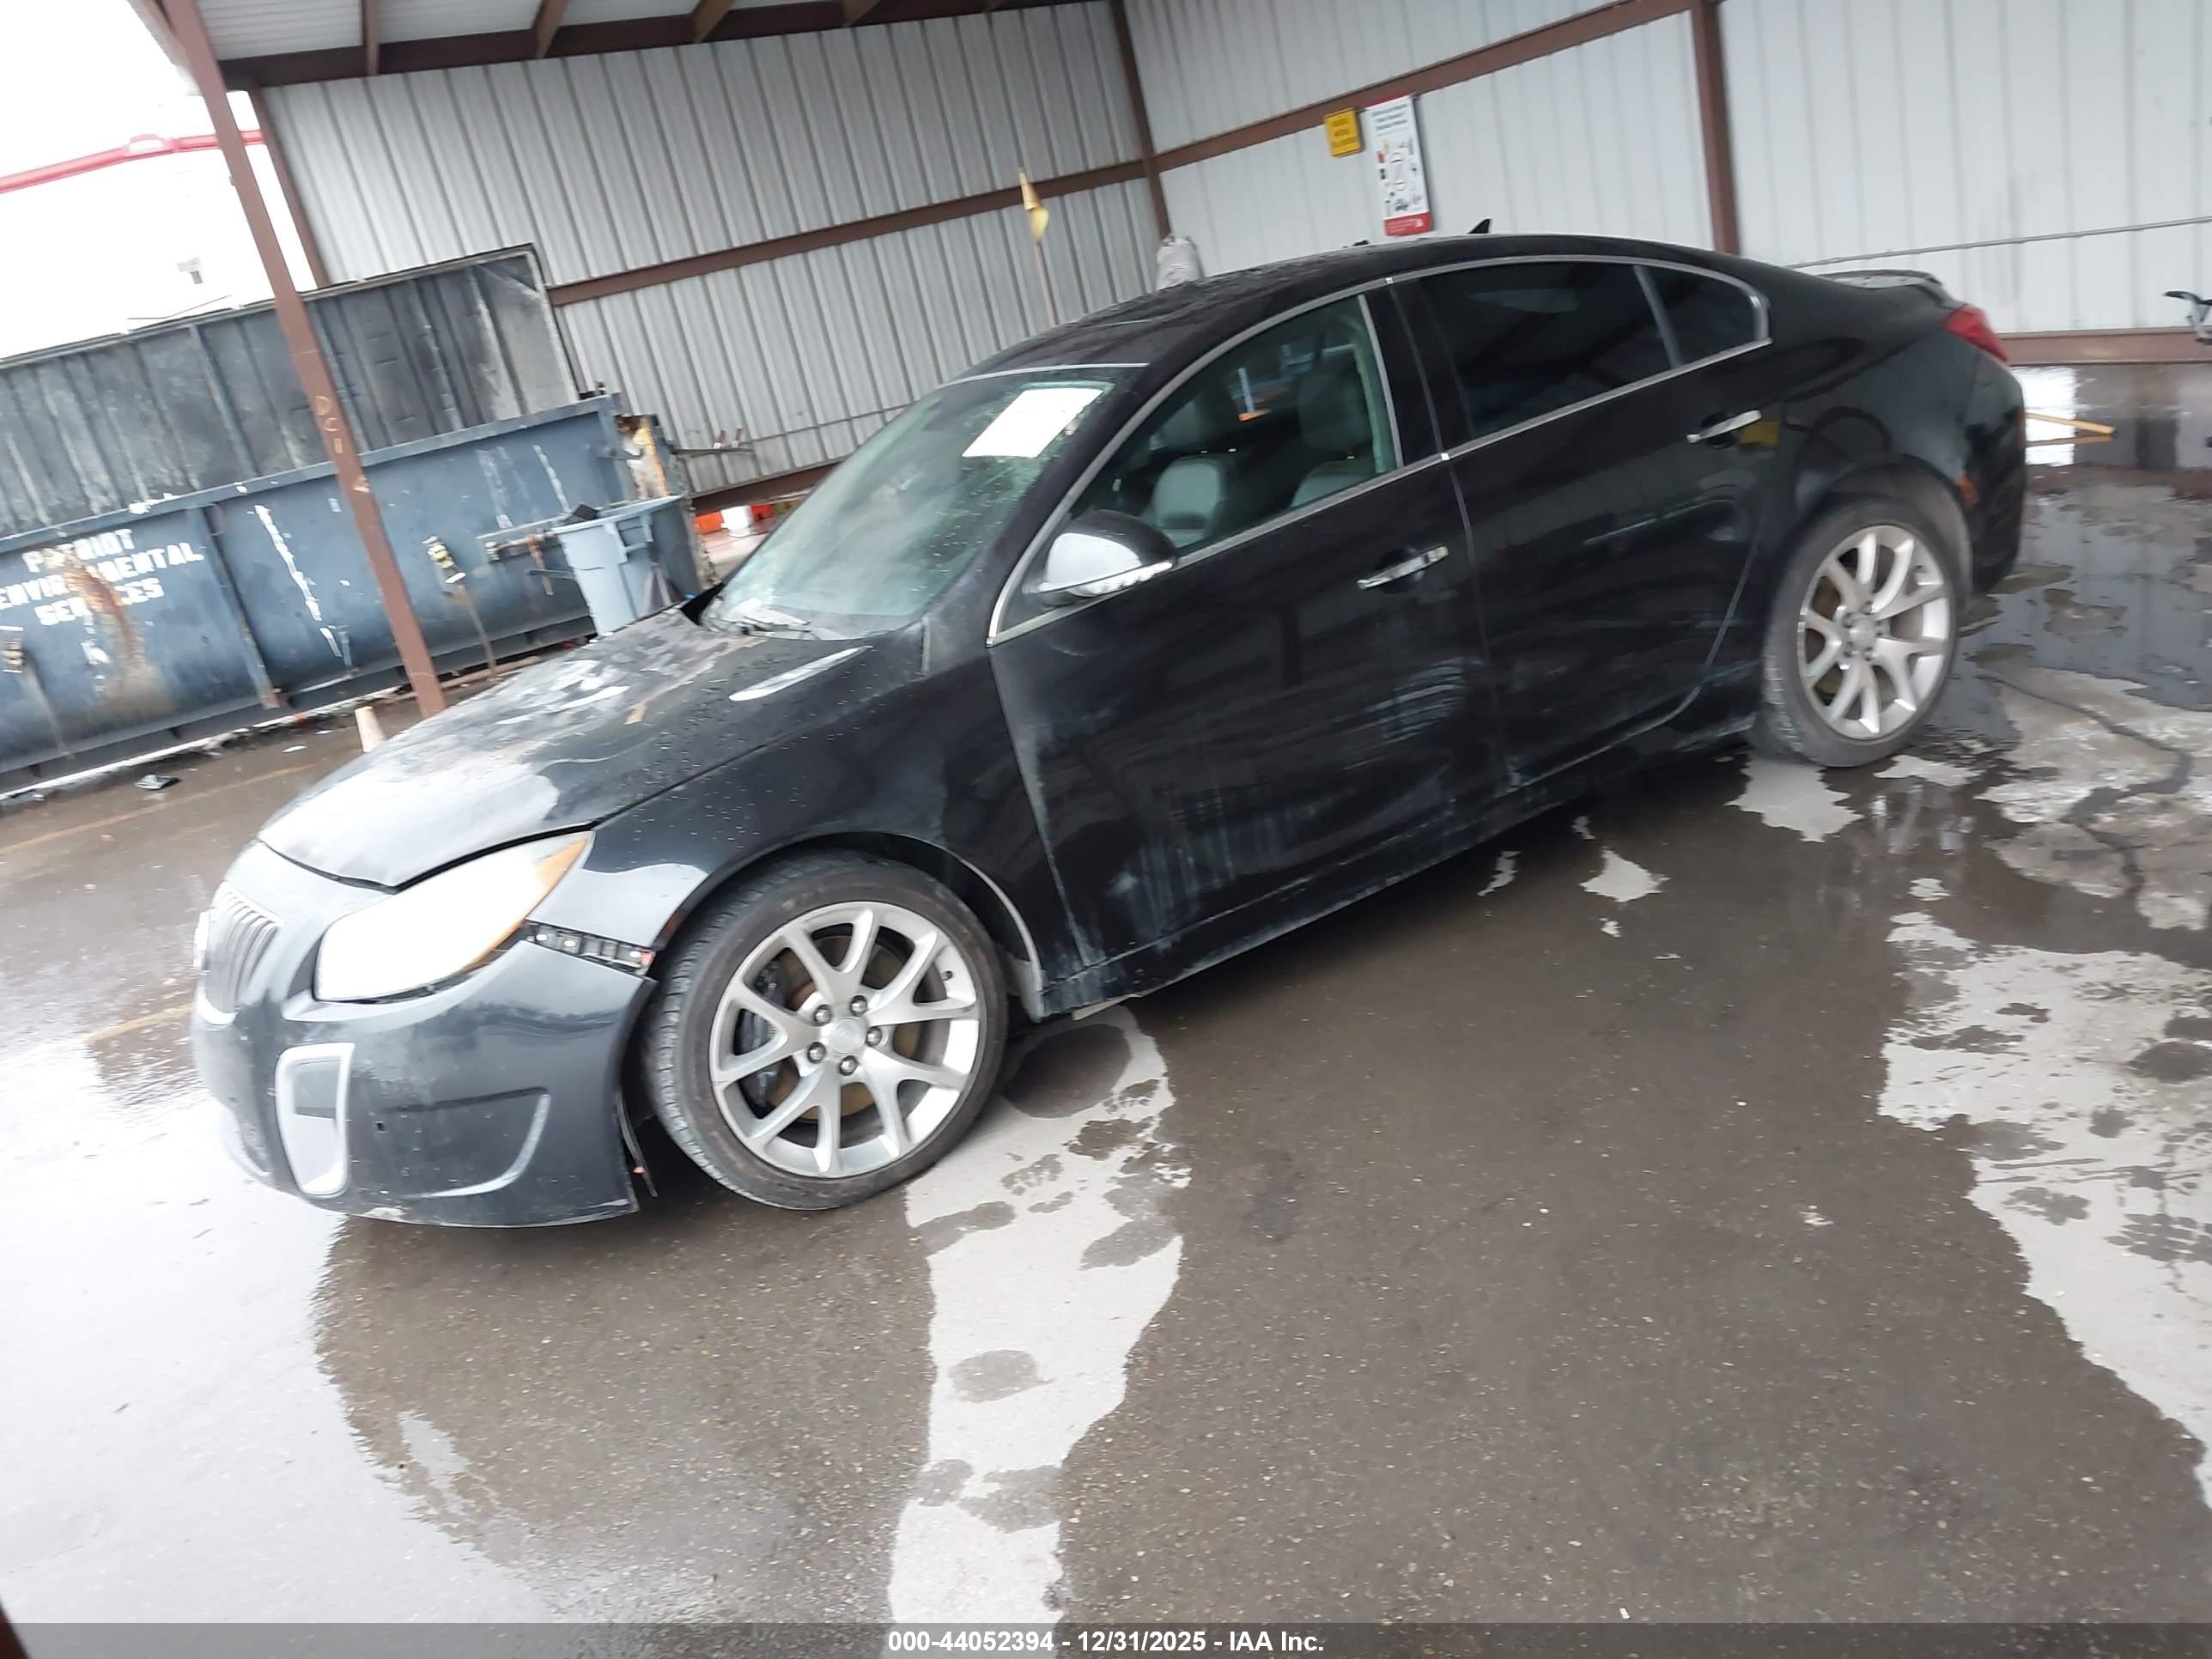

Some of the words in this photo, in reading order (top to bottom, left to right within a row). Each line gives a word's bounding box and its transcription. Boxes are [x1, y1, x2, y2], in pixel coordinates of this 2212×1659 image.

[21, 529, 135, 573] PATRIOT
[0, 543, 204, 610] ENVIRMENTAL
[34, 578, 165, 626] SERCES
